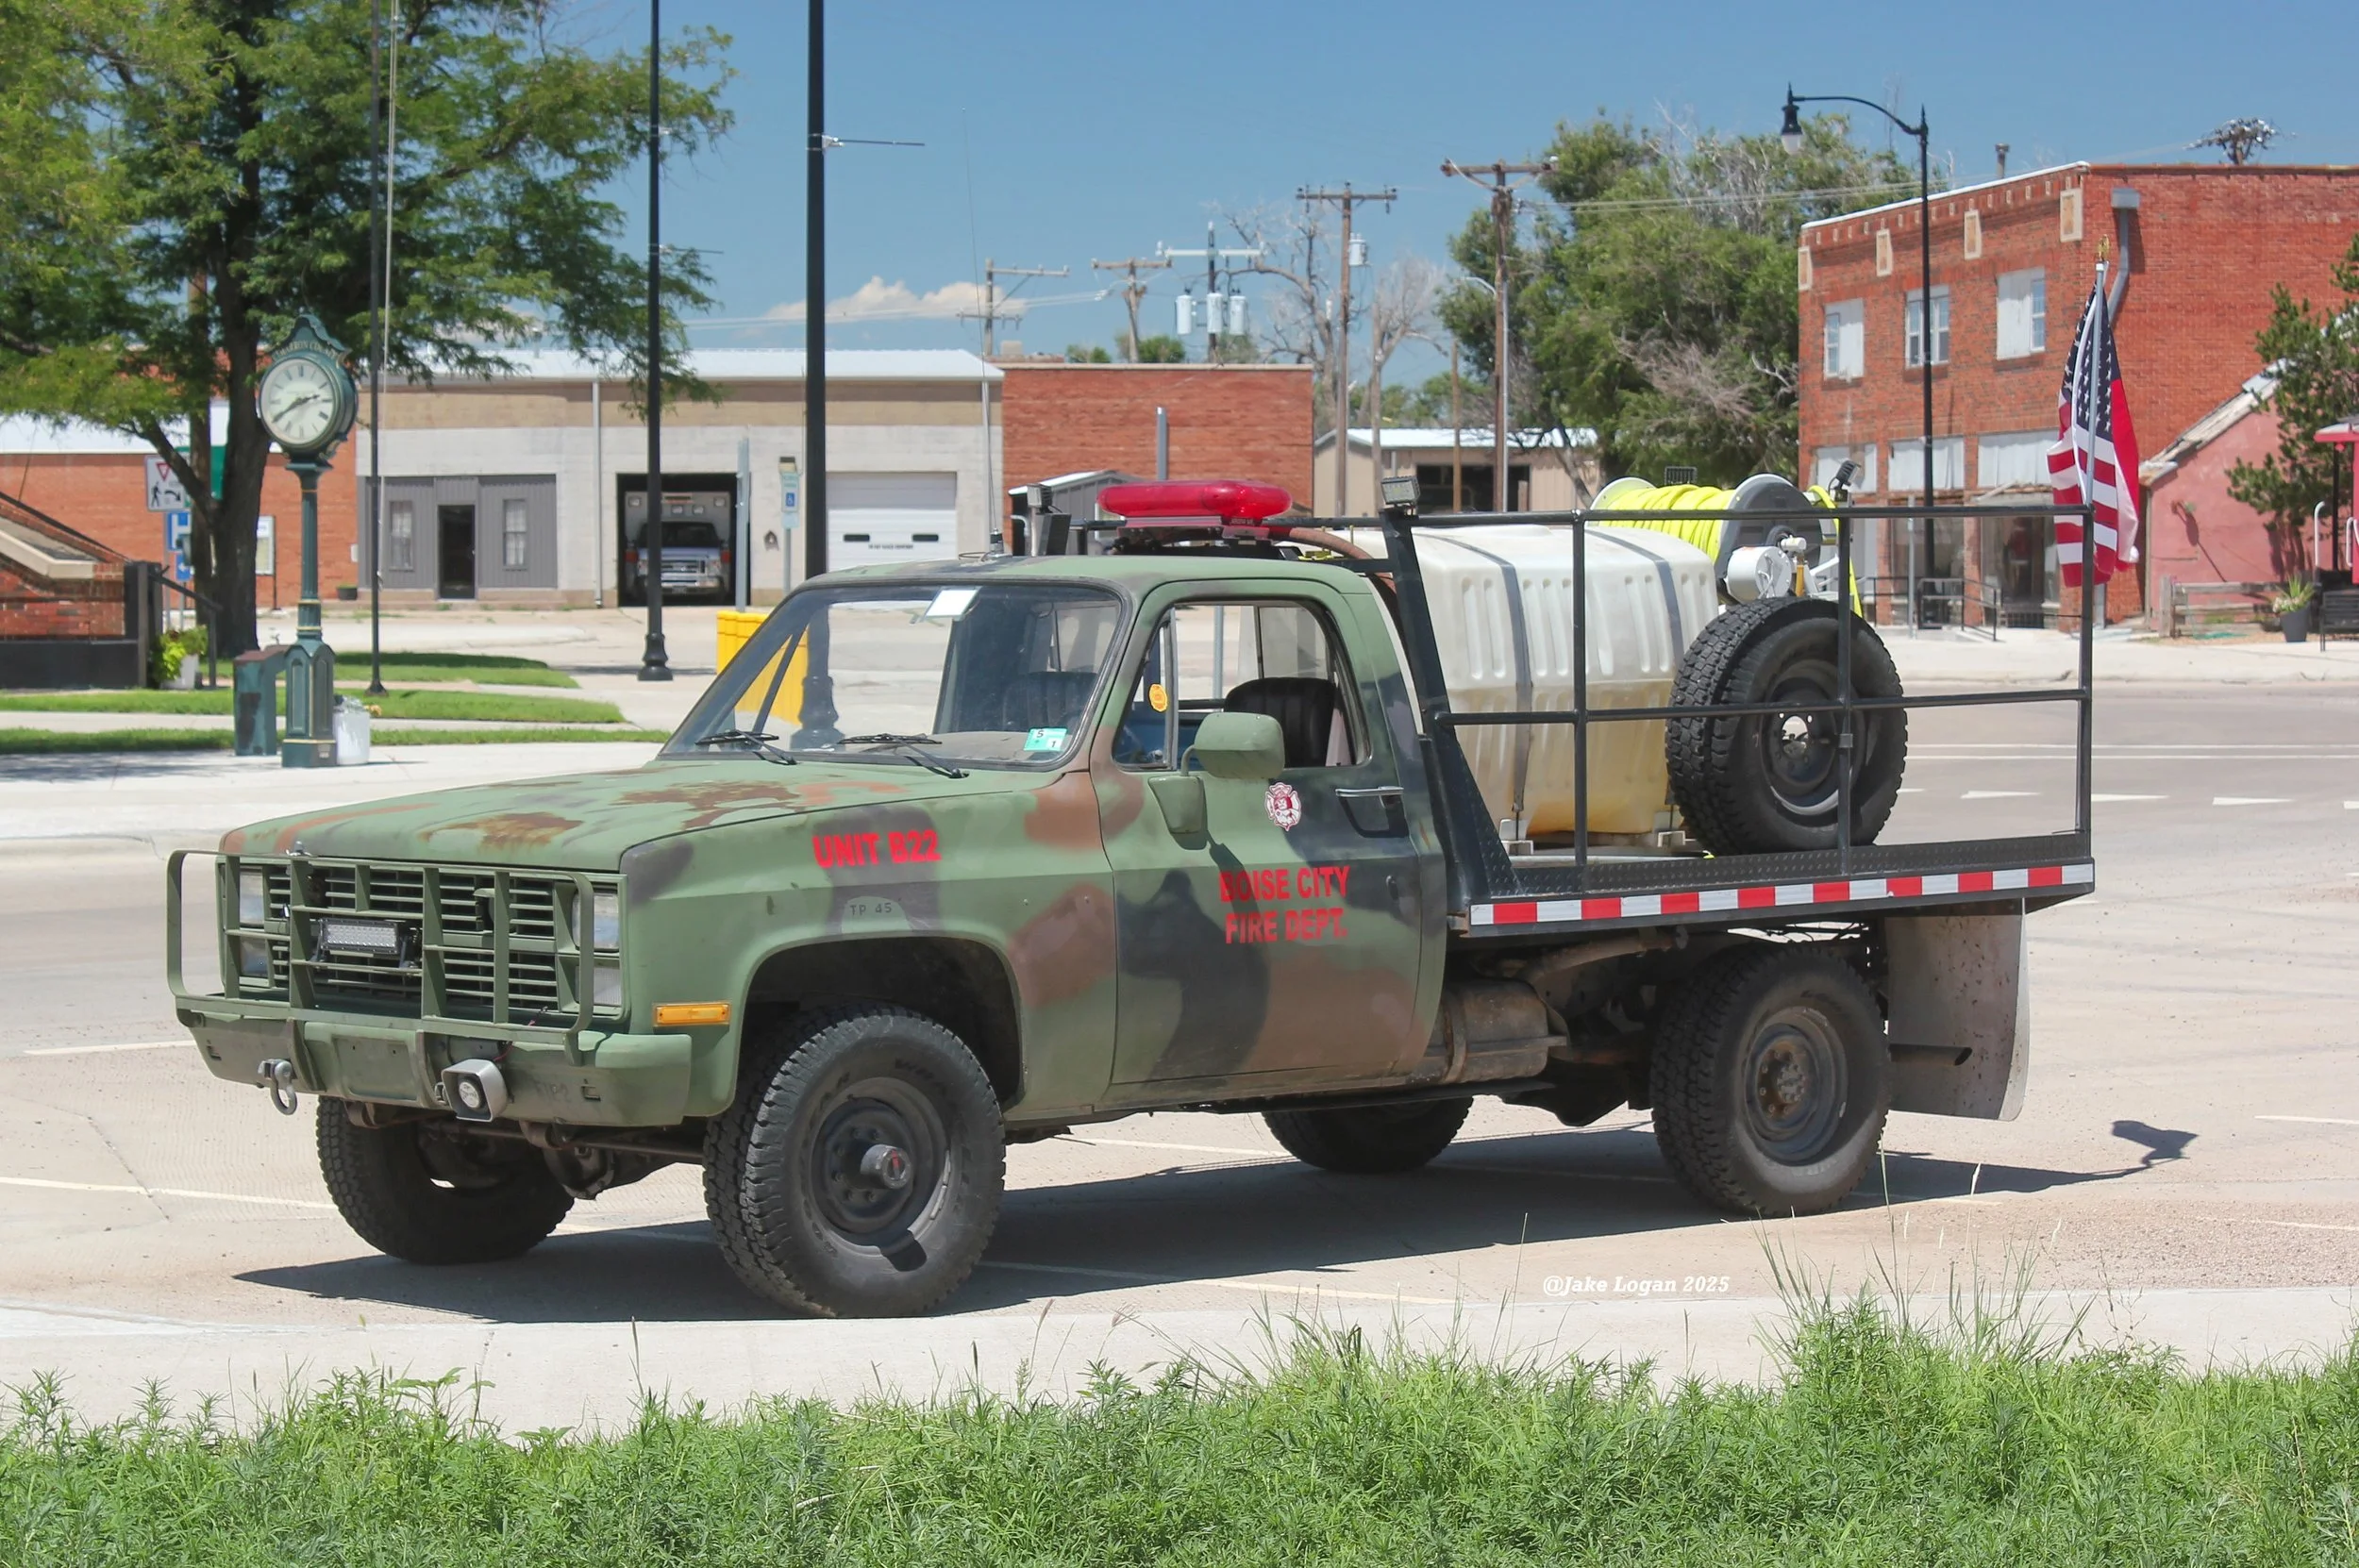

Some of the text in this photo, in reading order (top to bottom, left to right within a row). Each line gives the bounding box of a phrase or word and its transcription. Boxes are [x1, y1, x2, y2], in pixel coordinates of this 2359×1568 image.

[811, 828, 943, 869] UNIT B22
[1218, 865, 1350, 903] BOISE CITY
[849, 902, 893, 916] TP 45
[1225, 907, 1348, 944] FIRE DEPT.
